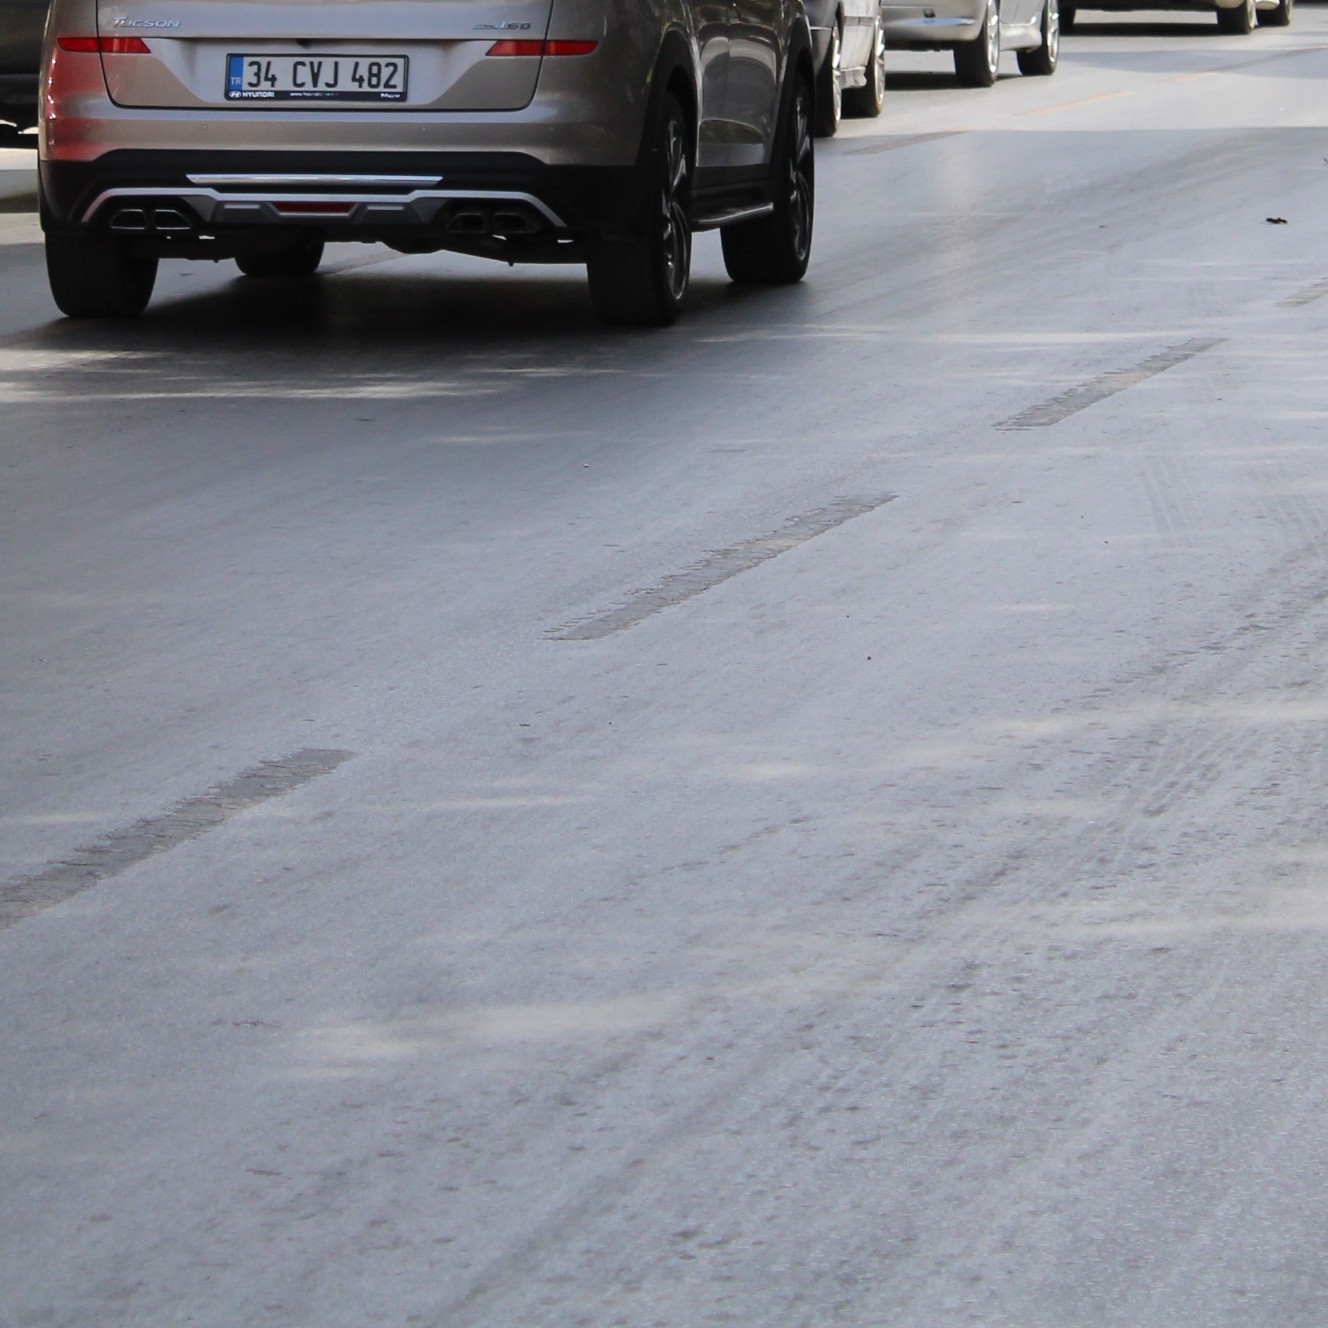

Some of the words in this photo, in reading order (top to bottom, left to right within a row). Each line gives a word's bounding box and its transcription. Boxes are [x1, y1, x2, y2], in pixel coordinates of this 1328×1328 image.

[113, 16, 182, 28] TUCSON
[247, 60, 277, 88] 34
[292, 60, 339, 88] CVJ
[351, 61, 399, 89] 482
[230, 77, 242, 86] TR
